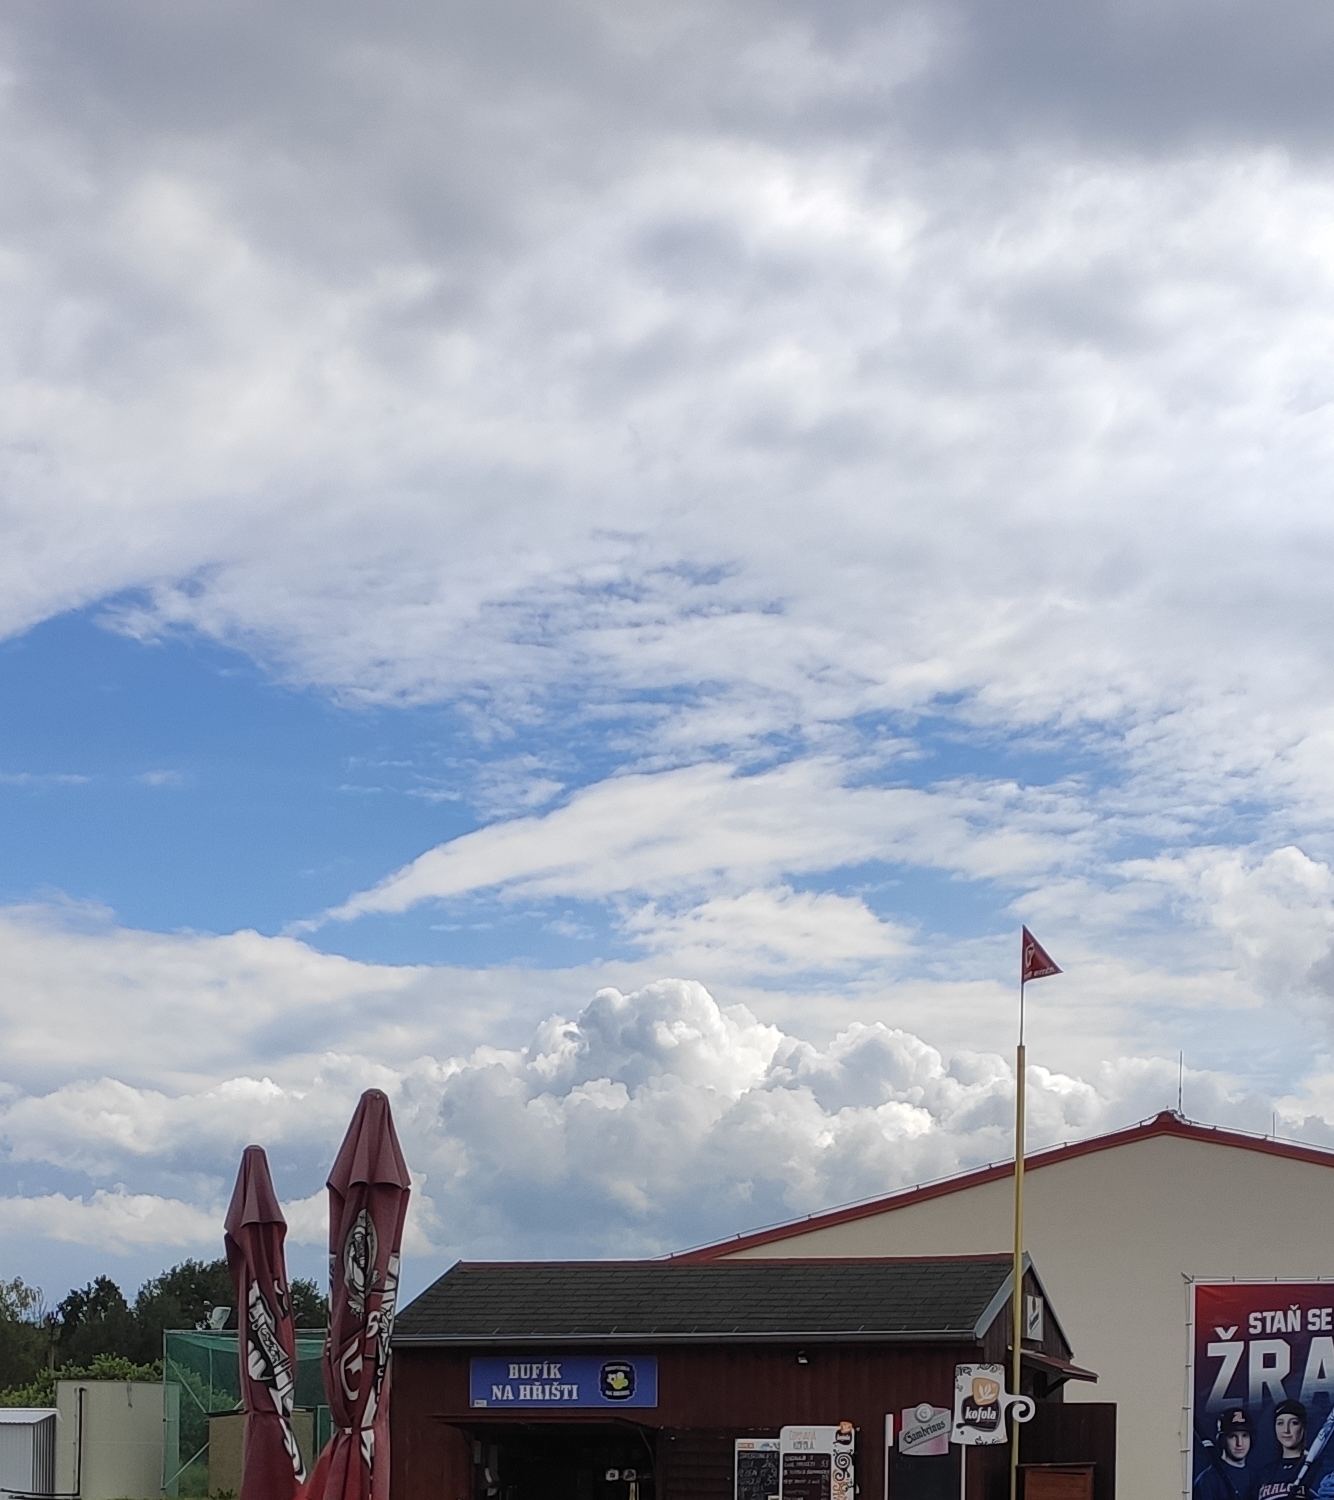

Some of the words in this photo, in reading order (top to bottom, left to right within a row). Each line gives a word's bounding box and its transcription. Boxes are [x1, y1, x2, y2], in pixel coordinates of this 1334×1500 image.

[1248, 1304, 1301, 1334] STAŇ
[1307, 1307, 1333, 1331] SE
[508, 1361, 562, 1379] BUFÍK
[492, 1384, 514, 1401] NA
[519, 1382, 579, 1401] HŘIŠTI
[965, 1406, 997, 1423] kofola
[903, 1419, 946, 1444] Gambrinus
